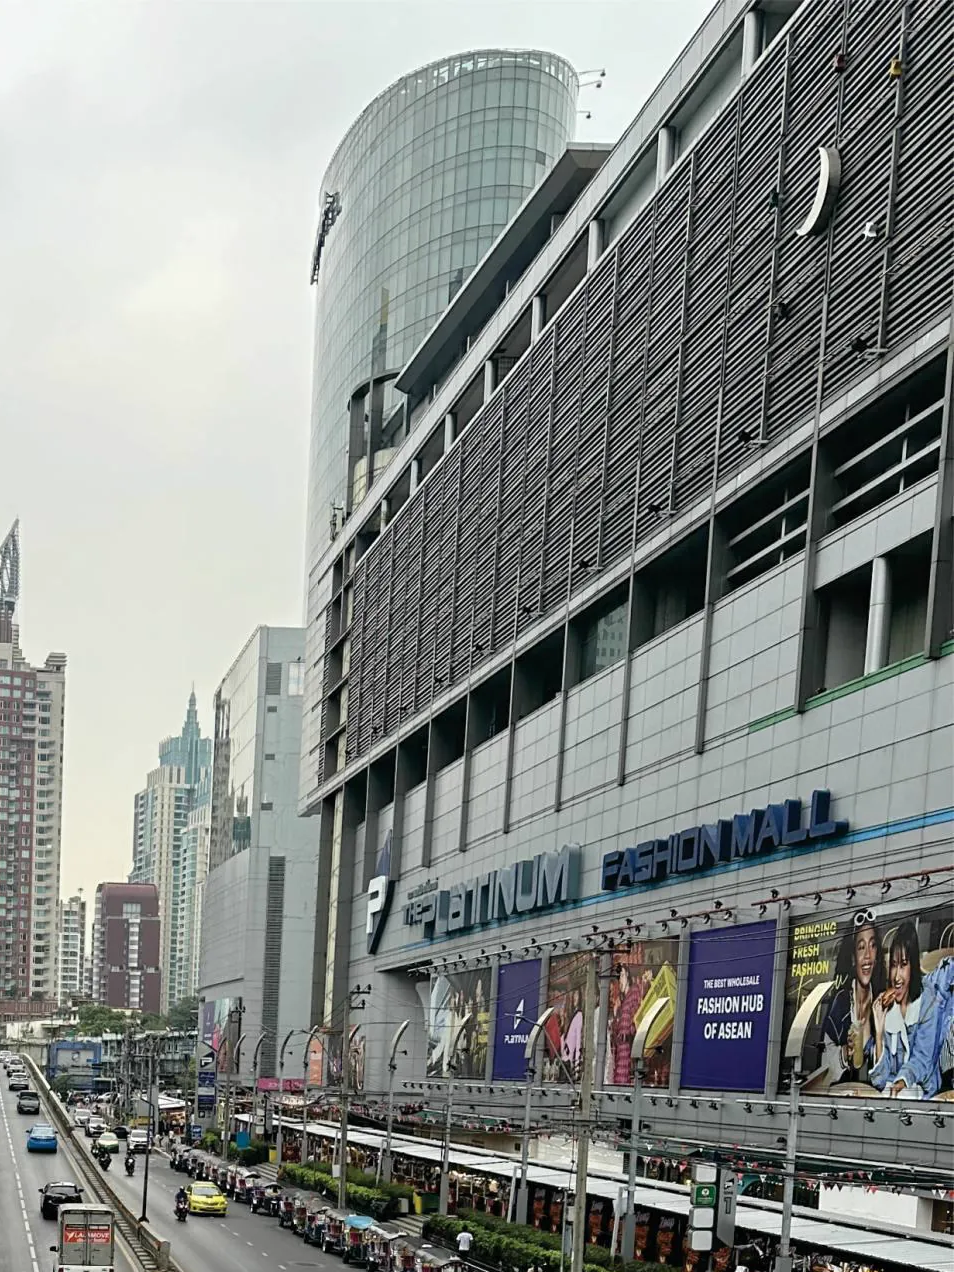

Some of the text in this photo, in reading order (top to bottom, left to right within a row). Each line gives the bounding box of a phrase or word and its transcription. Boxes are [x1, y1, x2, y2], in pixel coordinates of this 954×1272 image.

[602, 789, 850, 891] FASHION MALL
[792, 944, 820, 959] FRESH
[791, 960, 830, 977] FASHION
[703, 975, 760, 989] THE BEST WHOLESALE
[697, 994, 764, 1014] FASHION HUB
[704, 1021, 752, 1039] OF ASEAN
